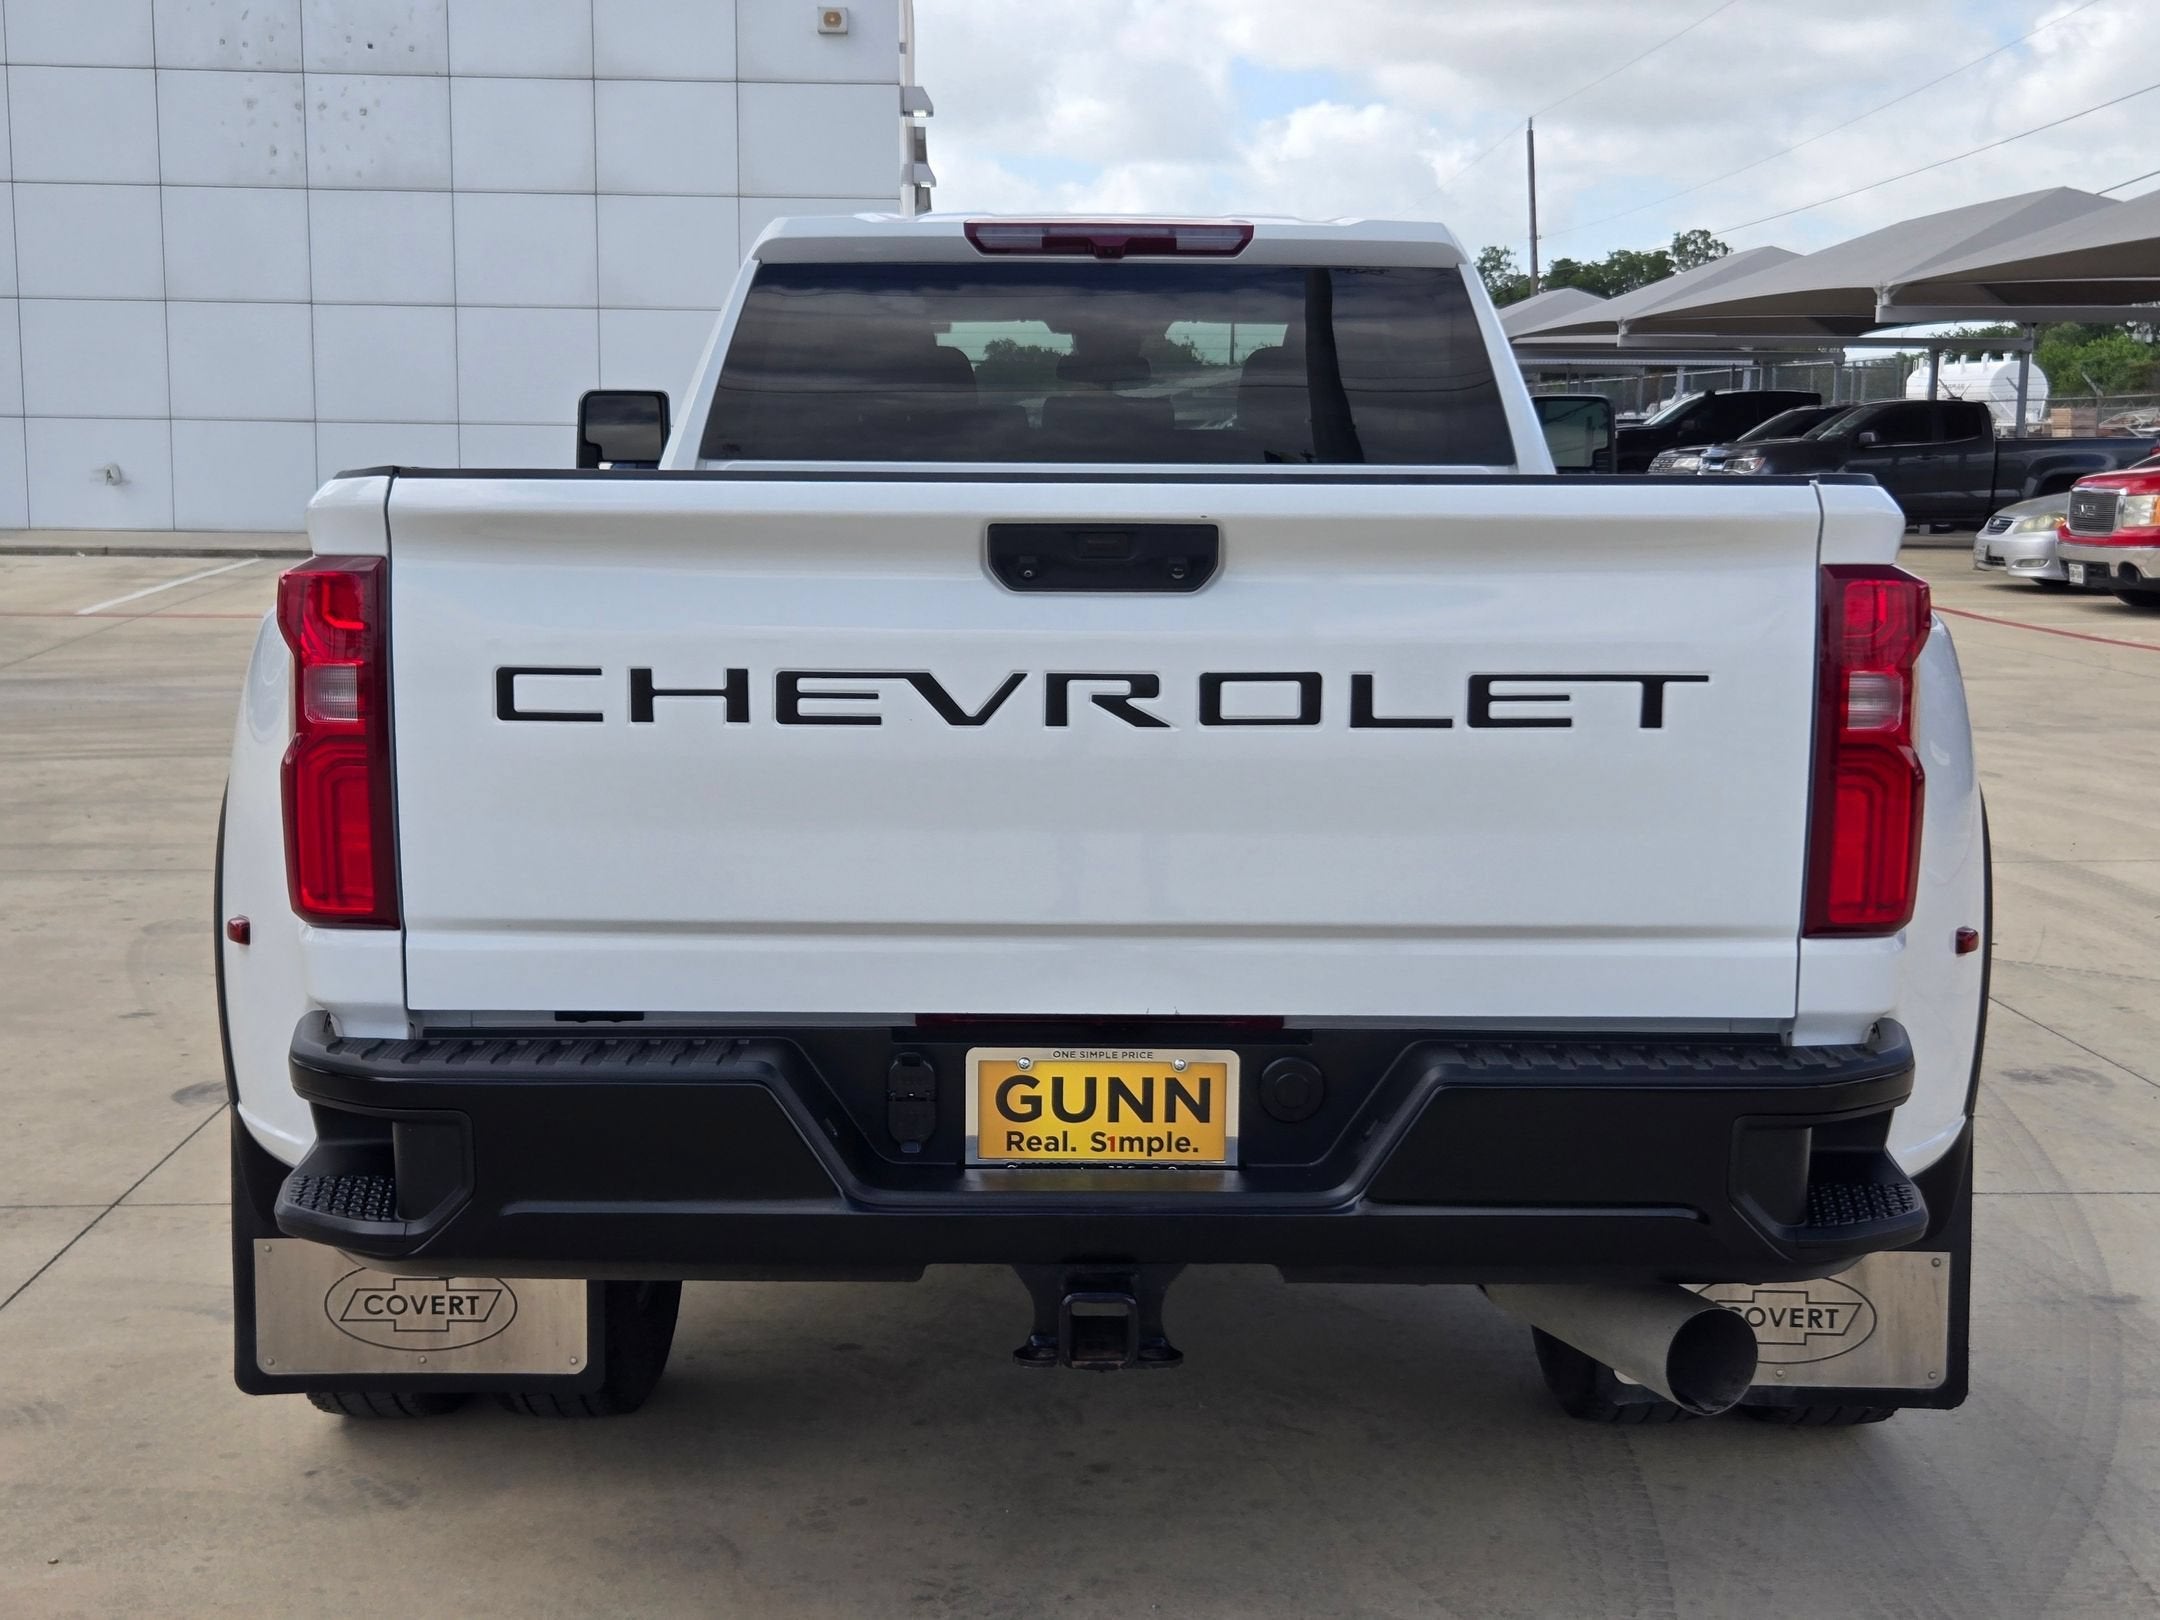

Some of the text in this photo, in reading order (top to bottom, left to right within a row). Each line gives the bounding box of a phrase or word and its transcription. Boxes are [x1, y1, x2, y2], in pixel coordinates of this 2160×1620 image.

[496, 667, 1709, 729] CHEVROLET
[1053, 1050, 1153, 1059] ONE SIMPLE PRICE
[995, 1074, 1211, 1124] GUNN
[1005, 1131, 1199, 1157] Real. S1mple.
[364, 1295, 480, 1316] COVERT
[1727, 1307, 1839, 1329] OVERT
